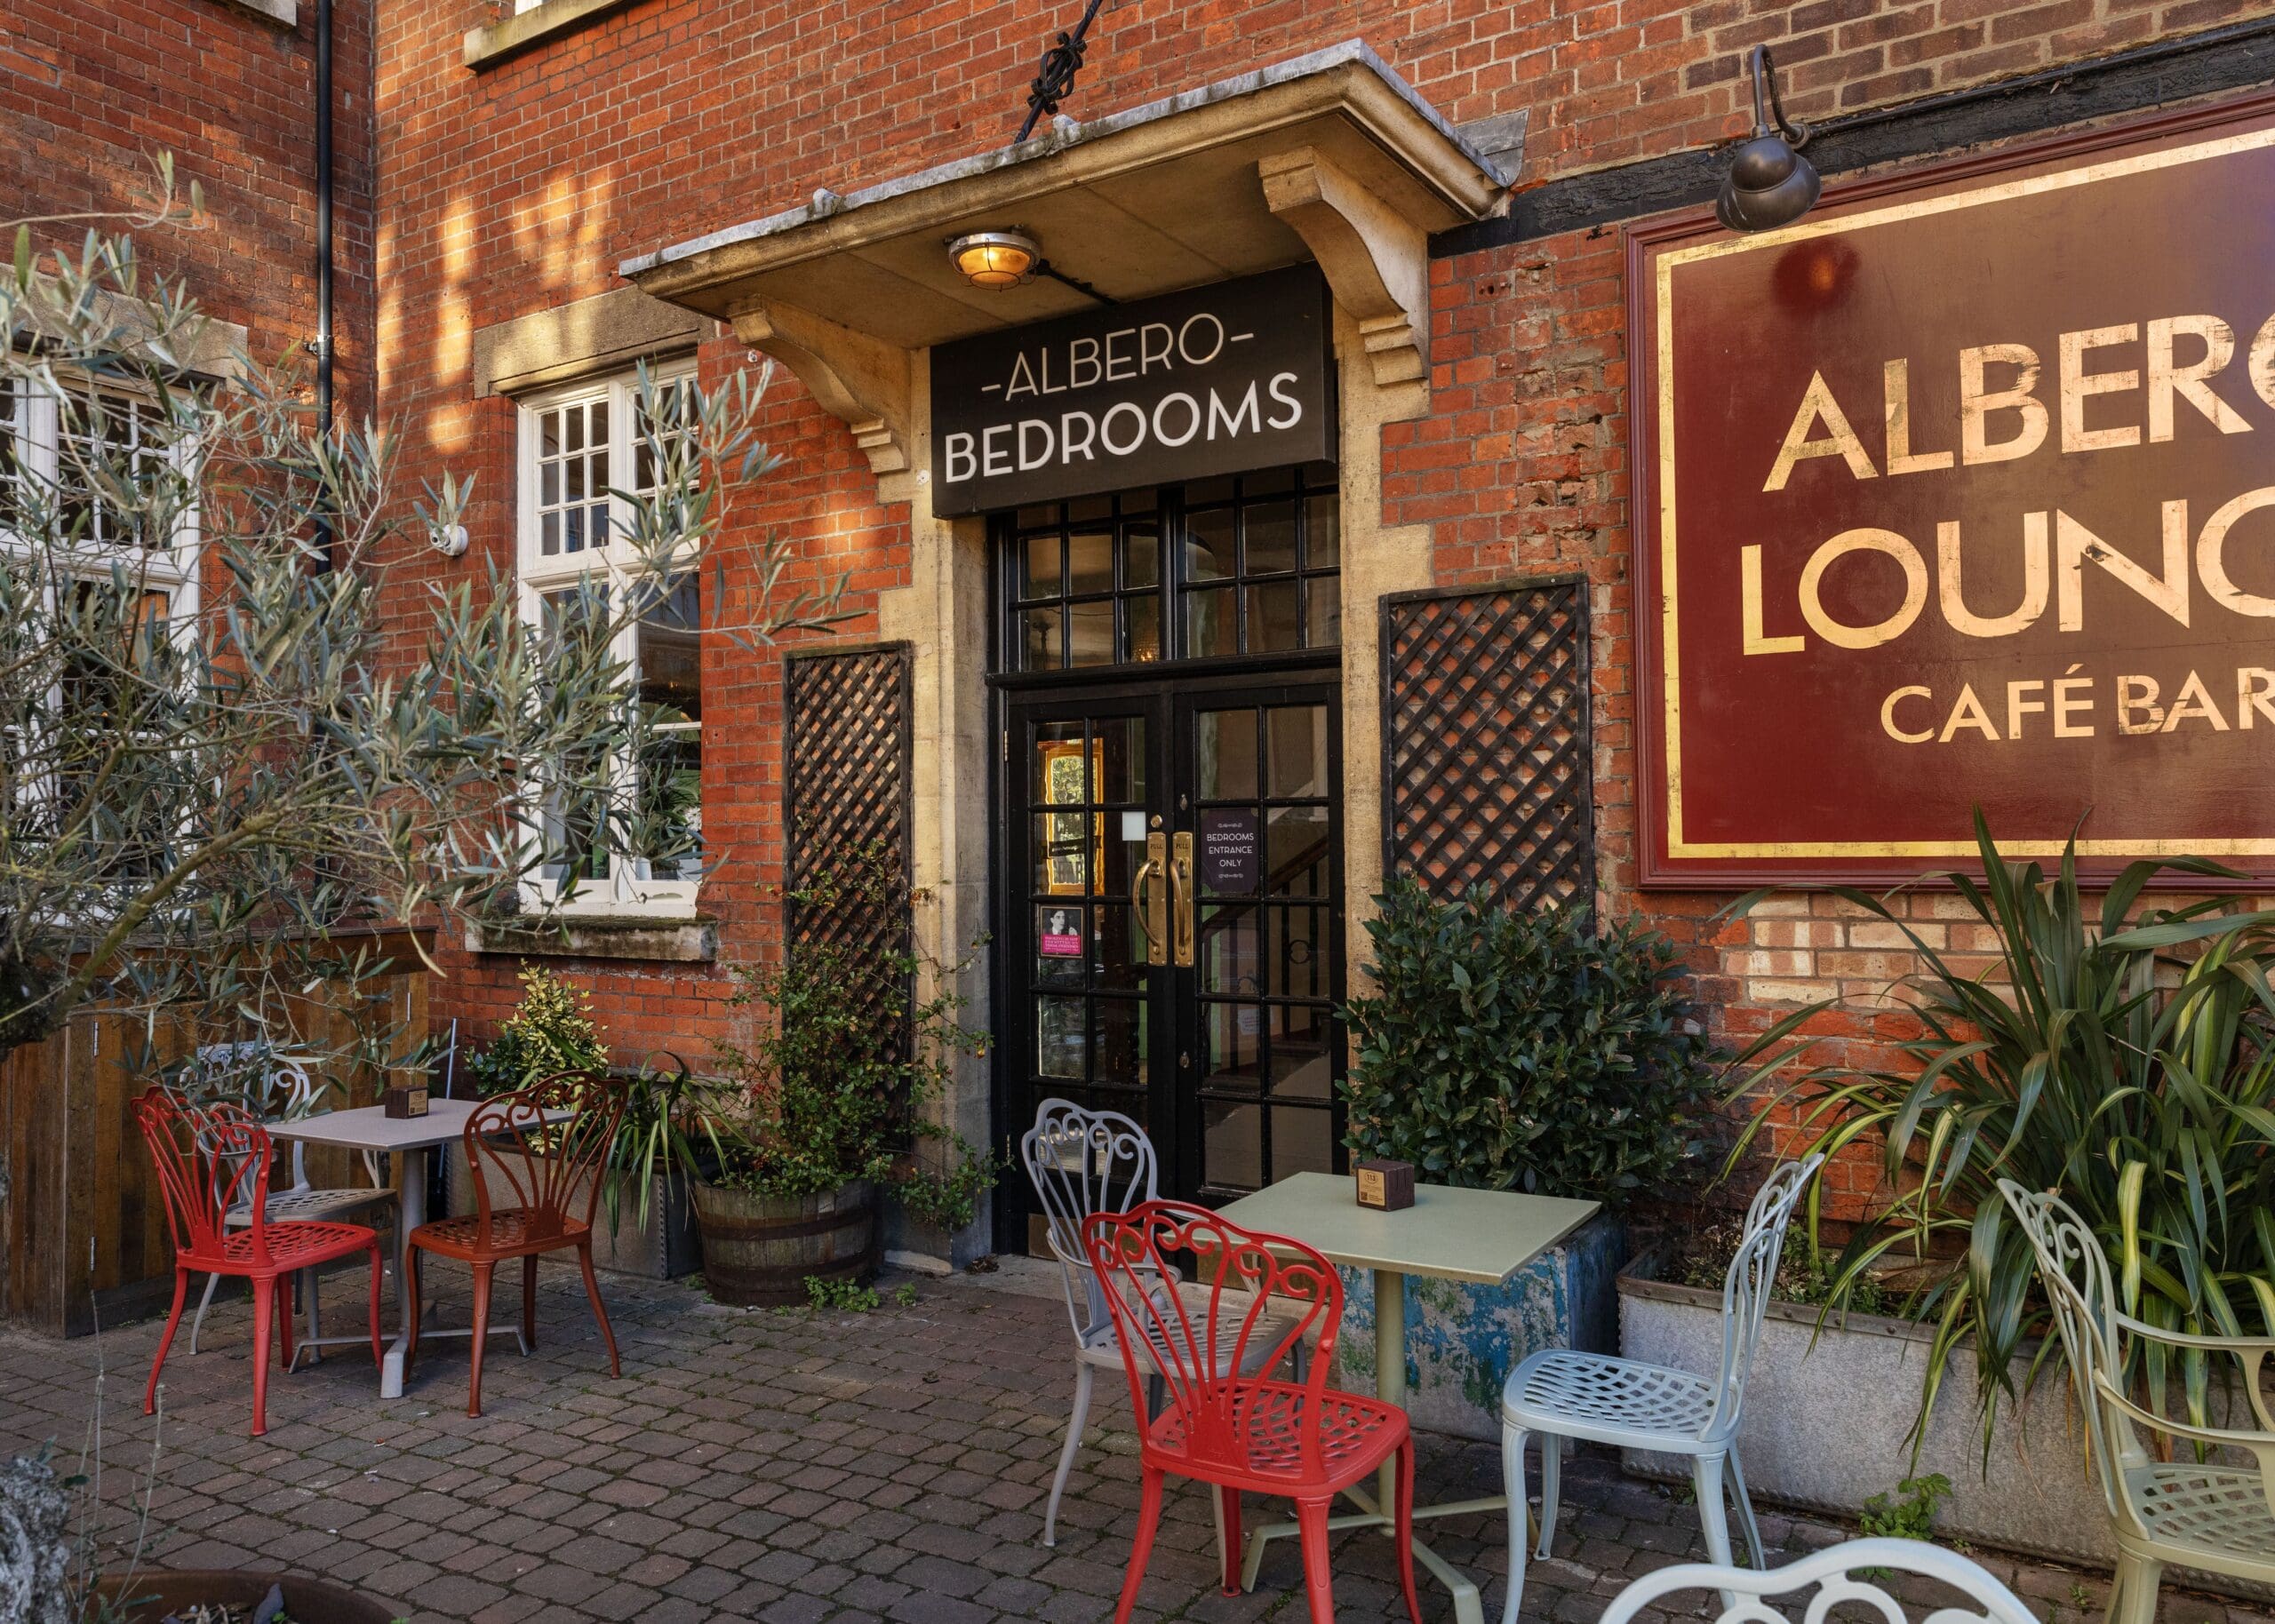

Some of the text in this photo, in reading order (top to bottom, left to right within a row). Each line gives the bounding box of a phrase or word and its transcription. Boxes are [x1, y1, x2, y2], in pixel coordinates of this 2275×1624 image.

[945, 371, 1303, 483] BEDROOMS
[1762, 311, 2275, 492] ALBER
[1880, 663, 2275, 744] CAFÉ BAR
[1207, 832, 1254, 841] BEDROOMS
